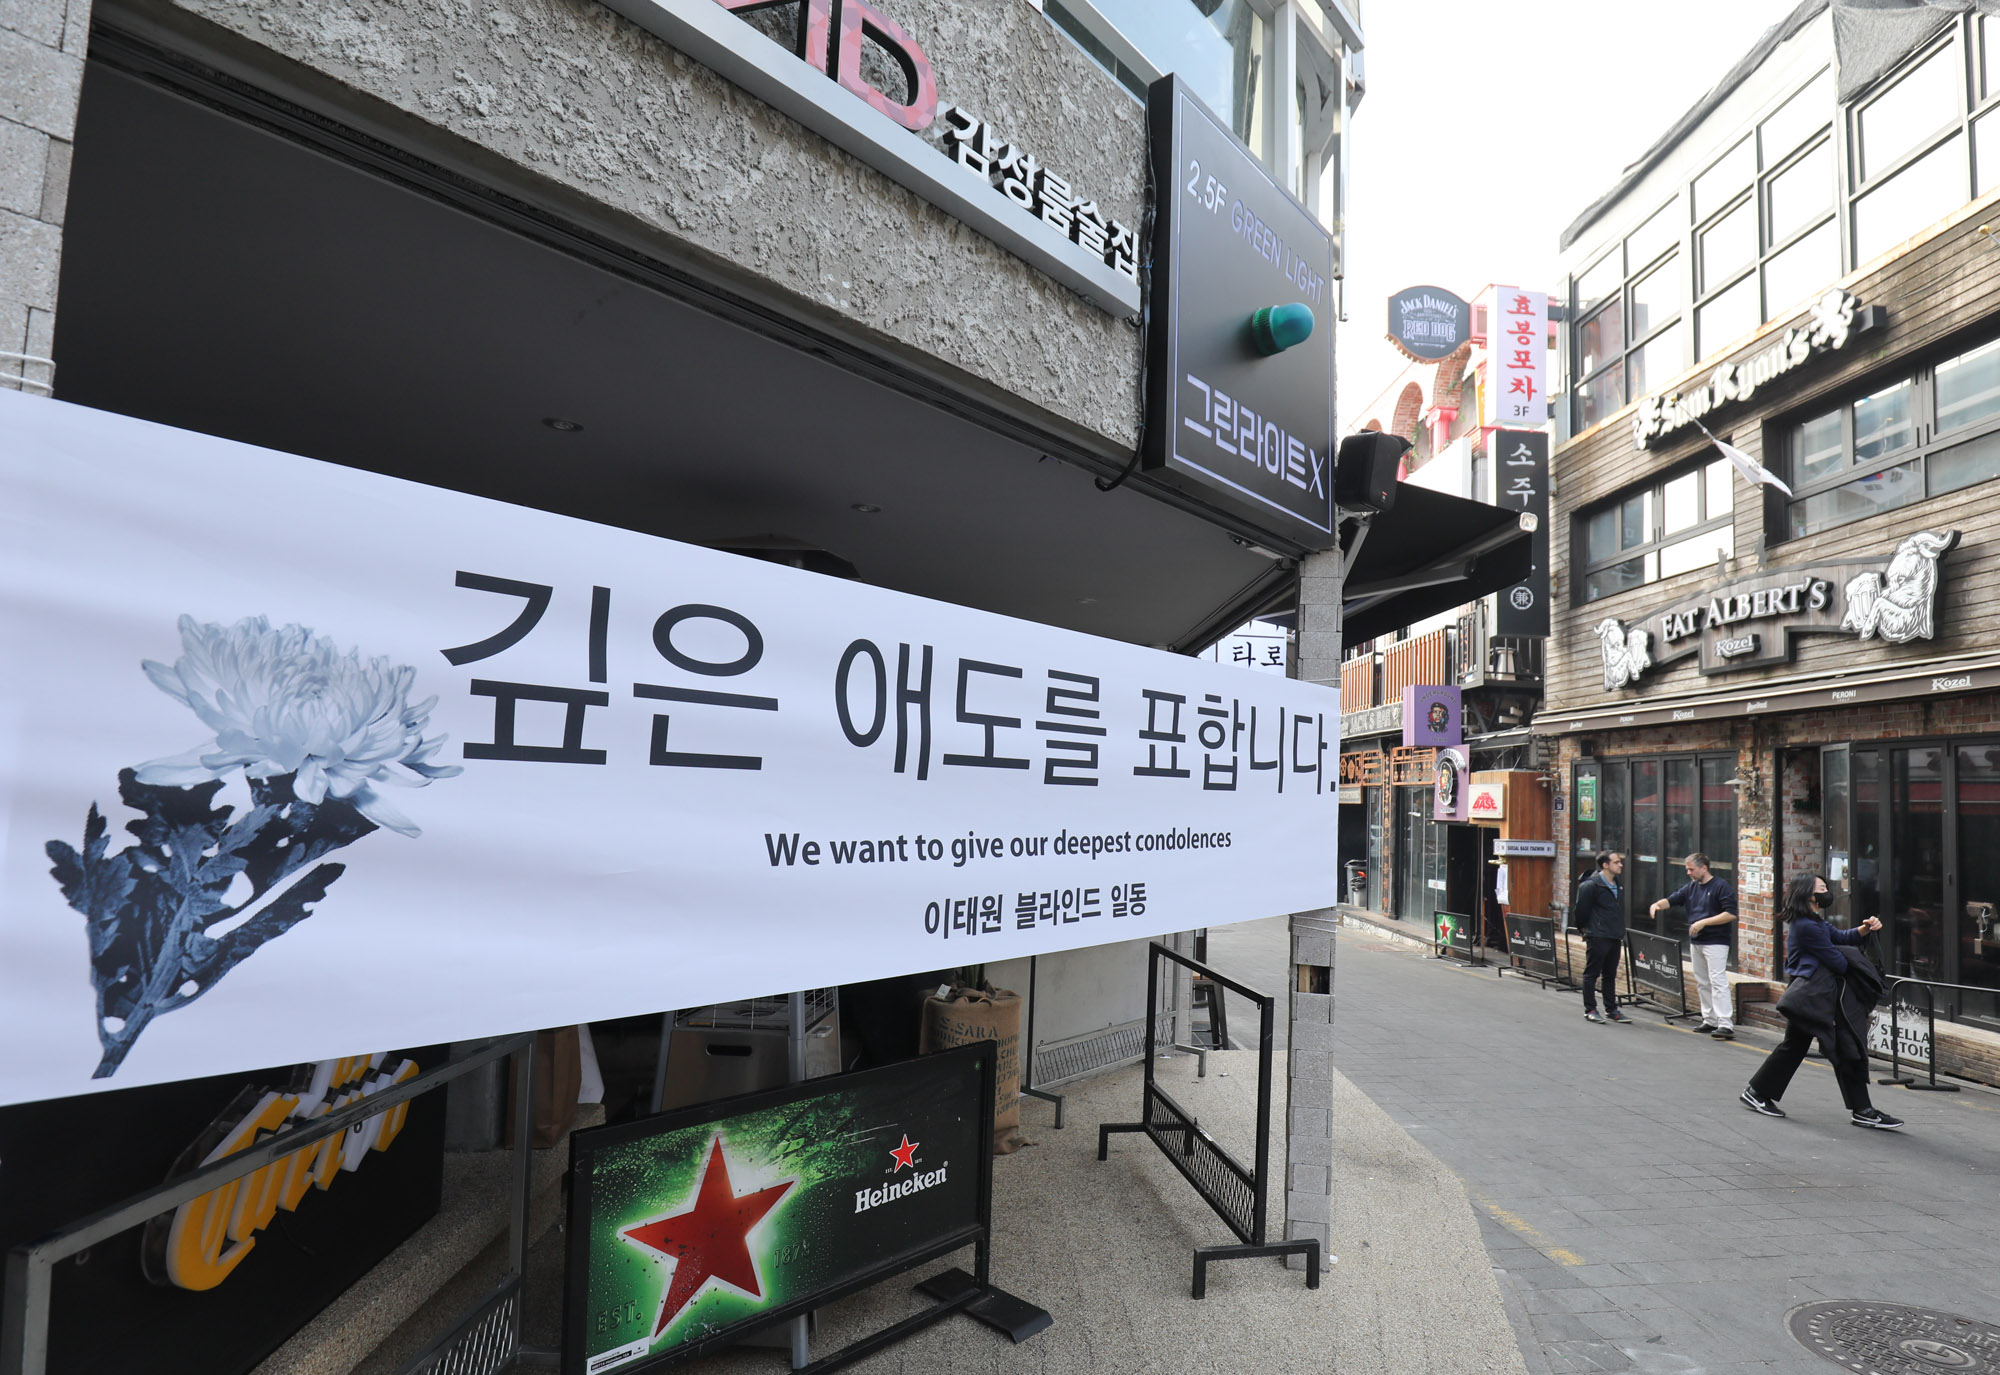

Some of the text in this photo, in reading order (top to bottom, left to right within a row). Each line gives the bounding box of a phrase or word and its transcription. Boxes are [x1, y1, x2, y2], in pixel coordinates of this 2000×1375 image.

[944, 104, 1139, 286] 감성룸술집
[1187, 160, 1326, 305] 2.5F GREEN LIGHT
[1400, 297, 1423, 314] JACK
[1403, 319, 1456, 343] RED DOG
[1513, 405, 1530, 417] 3F
[1184, 373, 1325, 500] 그린라이트X
[1660, 577, 1827, 644] FAT ALBERT'S
[1233, 641, 1284, 668] 타로
[1715, 634, 1755, 660] Kozel
[440, 570, 1336, 795] 깊은 애도를 표합니다.
[1832, 690, 1856, 699] PERONI
[1932, 676, 1971, 691] Kozel
[1472, 799, 1497, 810] BASE
[764, 827, 1232, 867] We want to give our deepest condolences
[924, 882, 1147, 940] 이태원 블라인드 일동
[855, 1167, 948, 1213] Heineken
[597, 1301, 642, 1334] EST.
